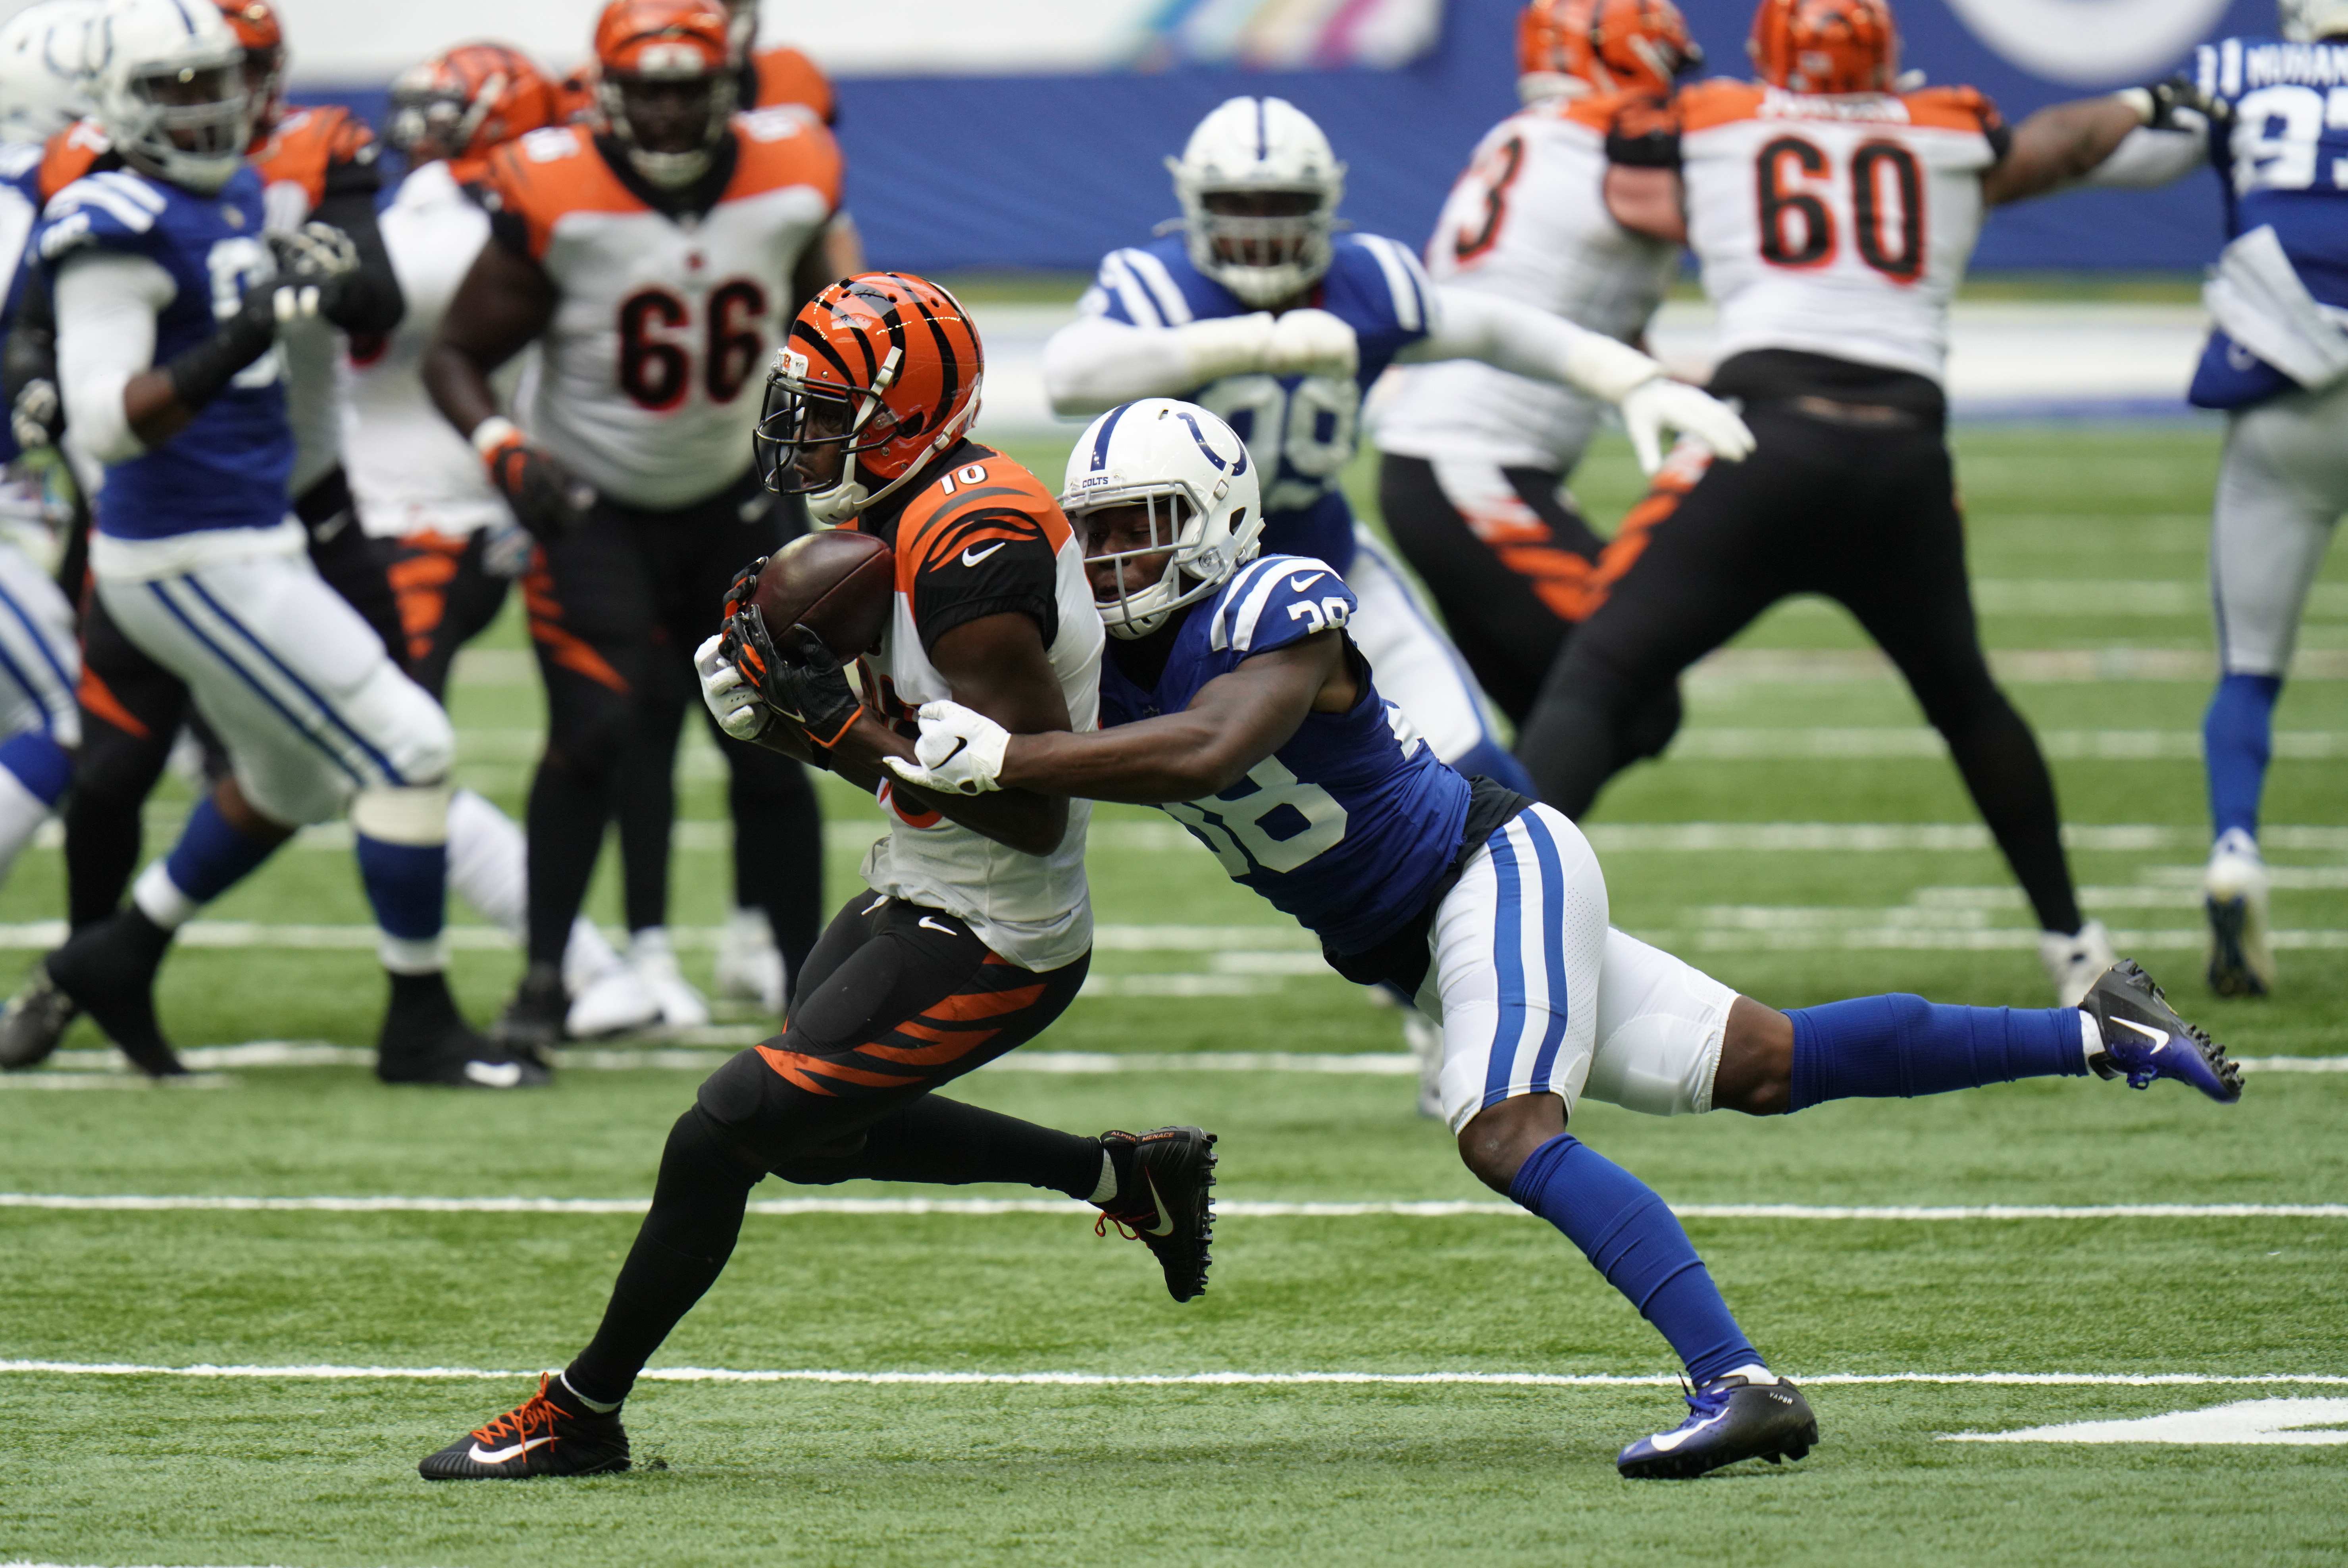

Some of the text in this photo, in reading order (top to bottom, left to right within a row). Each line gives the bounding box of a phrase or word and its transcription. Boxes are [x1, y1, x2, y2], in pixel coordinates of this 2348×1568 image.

[1757, 135, 1925, 288] 60
[618, 278, 767, 413] 66
[939, 464, 987, 495] 10
[1082, 477, 1109, 488] COLTS
[1111, 1131, 1174, 1142] ALPHA MENACE
[1769, 1391, 1793, 1405] VAPOR
